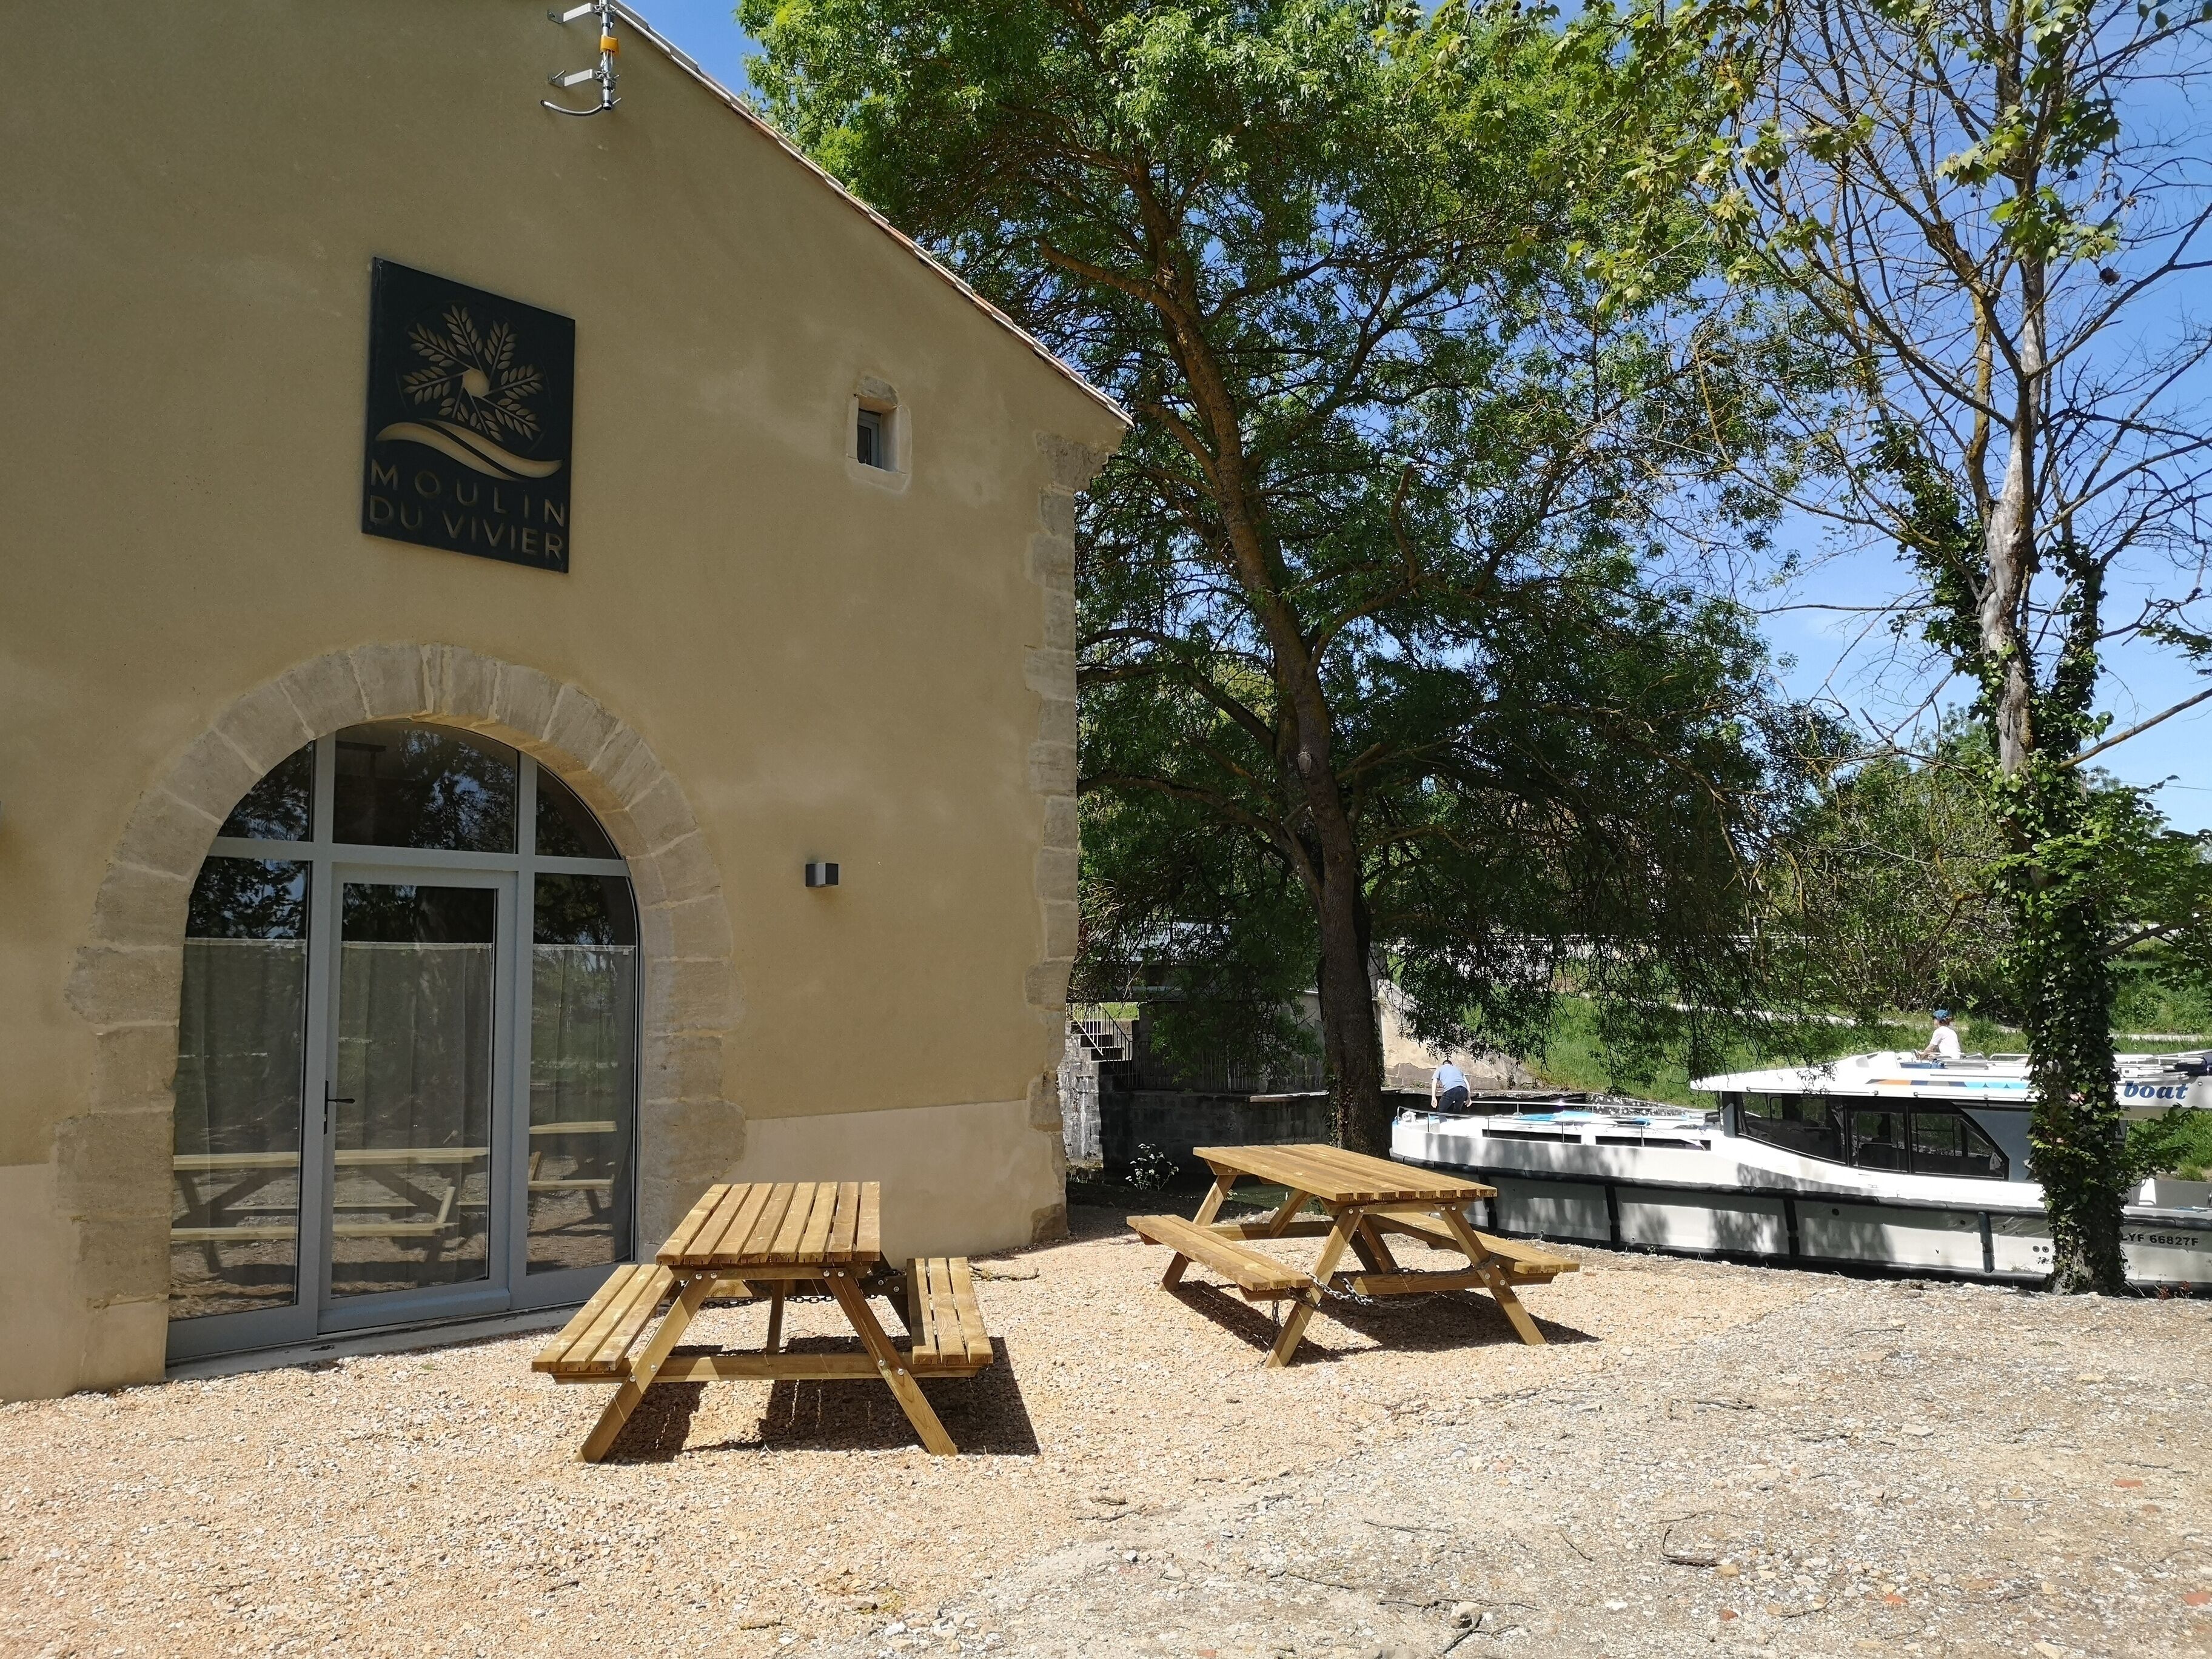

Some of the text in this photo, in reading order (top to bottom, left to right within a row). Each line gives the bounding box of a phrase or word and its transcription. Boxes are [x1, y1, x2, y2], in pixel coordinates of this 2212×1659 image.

[370, 458, 565, 527] MOULIN
[369, 495, 564, 560] DU VIVIER
[2123, 1081, 2188, 1099] boat
[2150, 1235, 2199, 1246] 66827F
